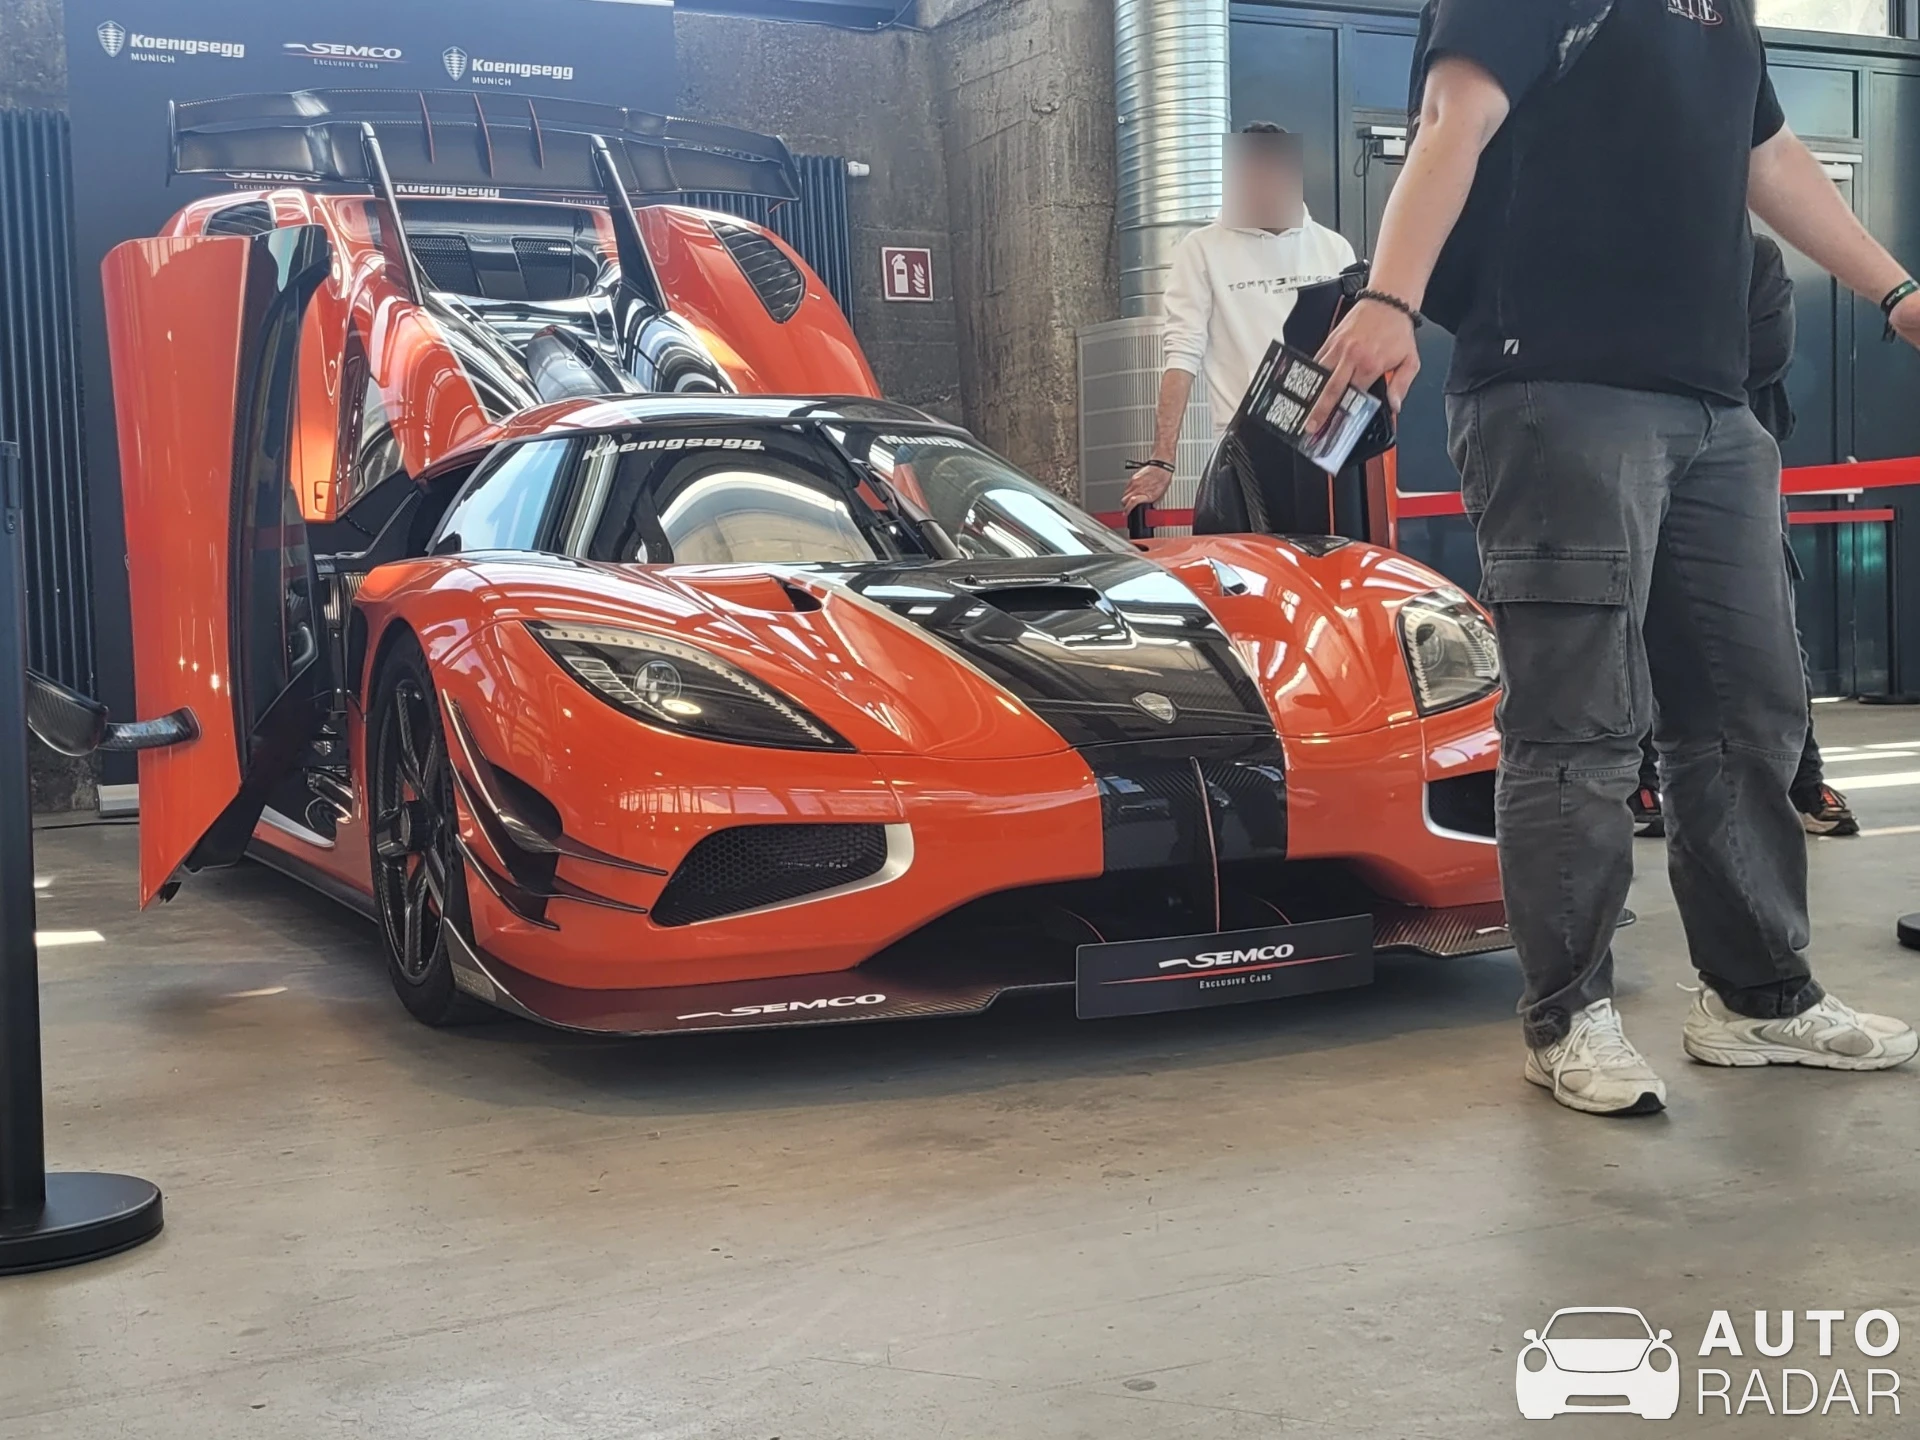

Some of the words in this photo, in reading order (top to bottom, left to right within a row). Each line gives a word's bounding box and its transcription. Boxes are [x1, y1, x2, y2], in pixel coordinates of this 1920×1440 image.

[130, 33, 245, 58] Koenigsegg
[308, 43, 402, 59] SEMCO
[131, 52, 175, 63] MUNICH
[472, 58, 574, 80] Koenigsegg
[472, 76, 512, 86] MUNICH
[1228, 279, 1272, 292] TOMMY
[582, 438, 765, 461] Koenigsegg
[1189, 944, 1295, 969] SEMCO
[725, 994, 886, 1017] SEMCO
